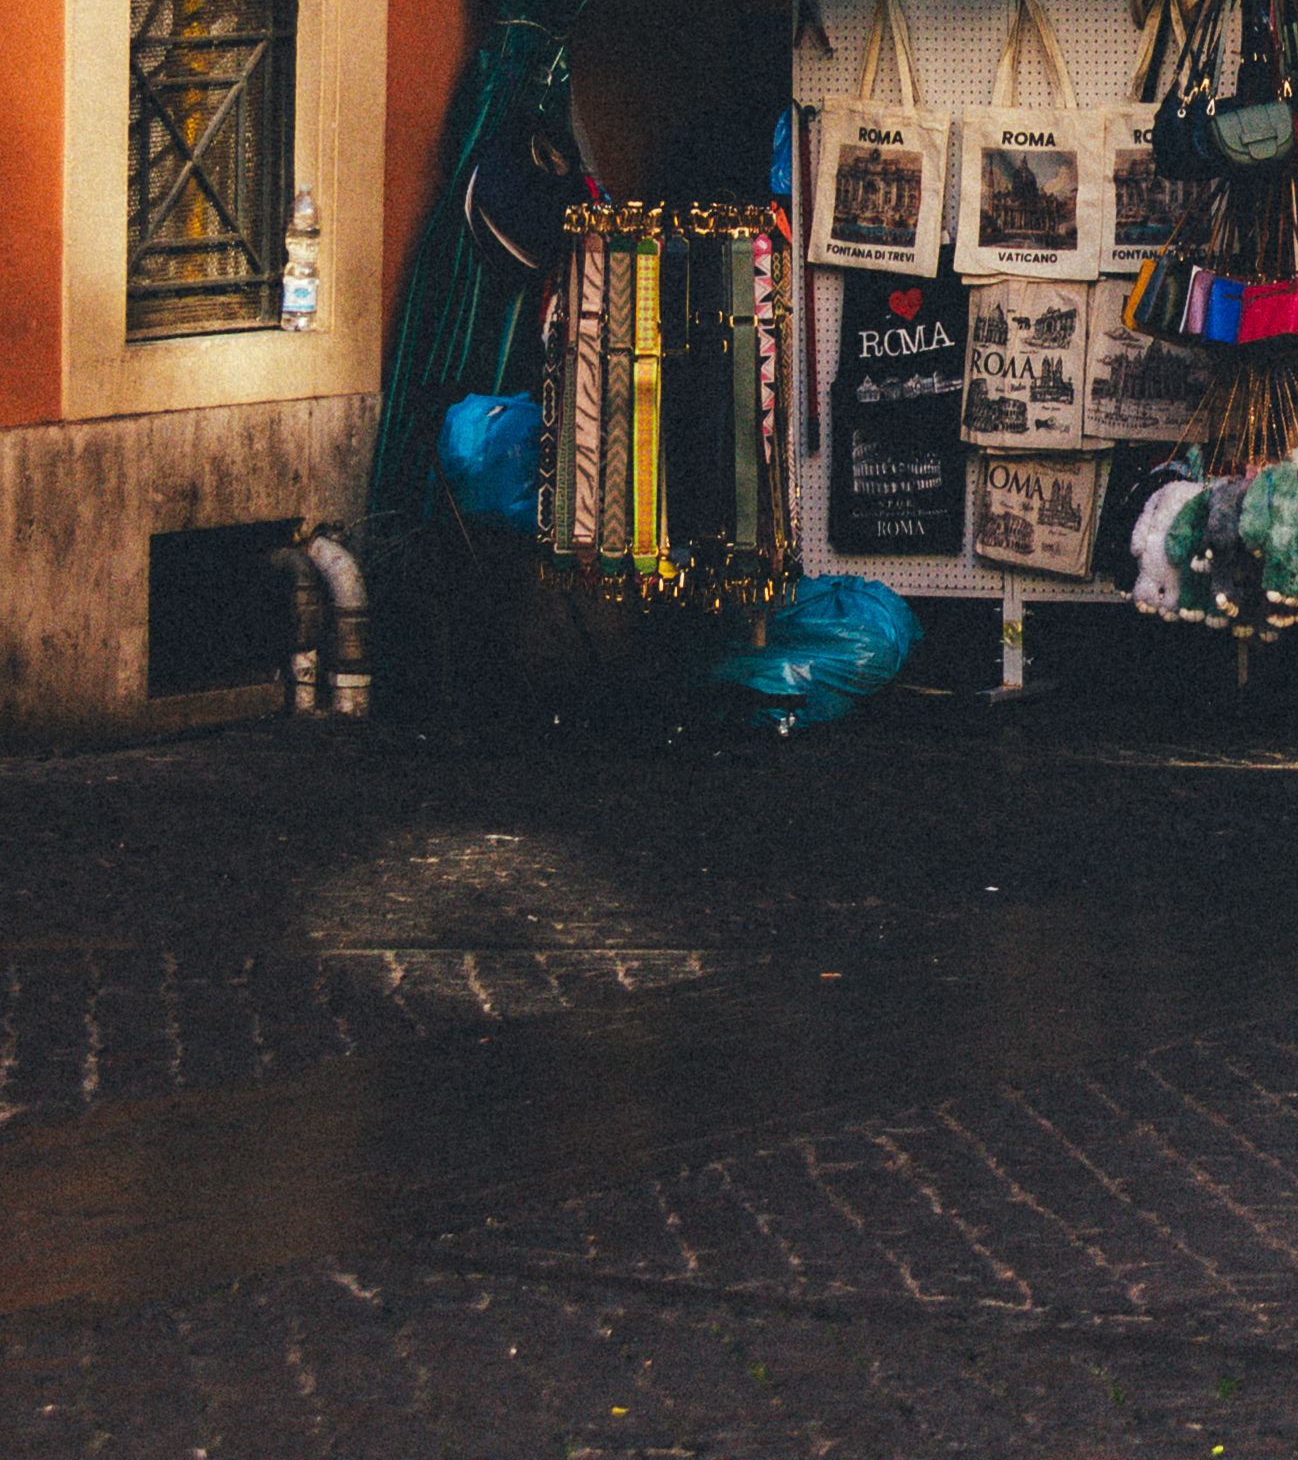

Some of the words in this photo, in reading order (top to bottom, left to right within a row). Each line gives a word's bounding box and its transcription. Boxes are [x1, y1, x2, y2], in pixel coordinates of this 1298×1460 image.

[858, 127, 904, 146] ROMA
[1001, 130, 1056, 147] ROMA
[1133, 128, 1153, 144] RO
[826, 243, 873, 260] FONTANA
[874, 249, 885, 260] DI
[888, 249, 915, 263] TREVI
[998, 251, 1058, 263] VATICANO
[877, 520, 925, 537] ROMA
